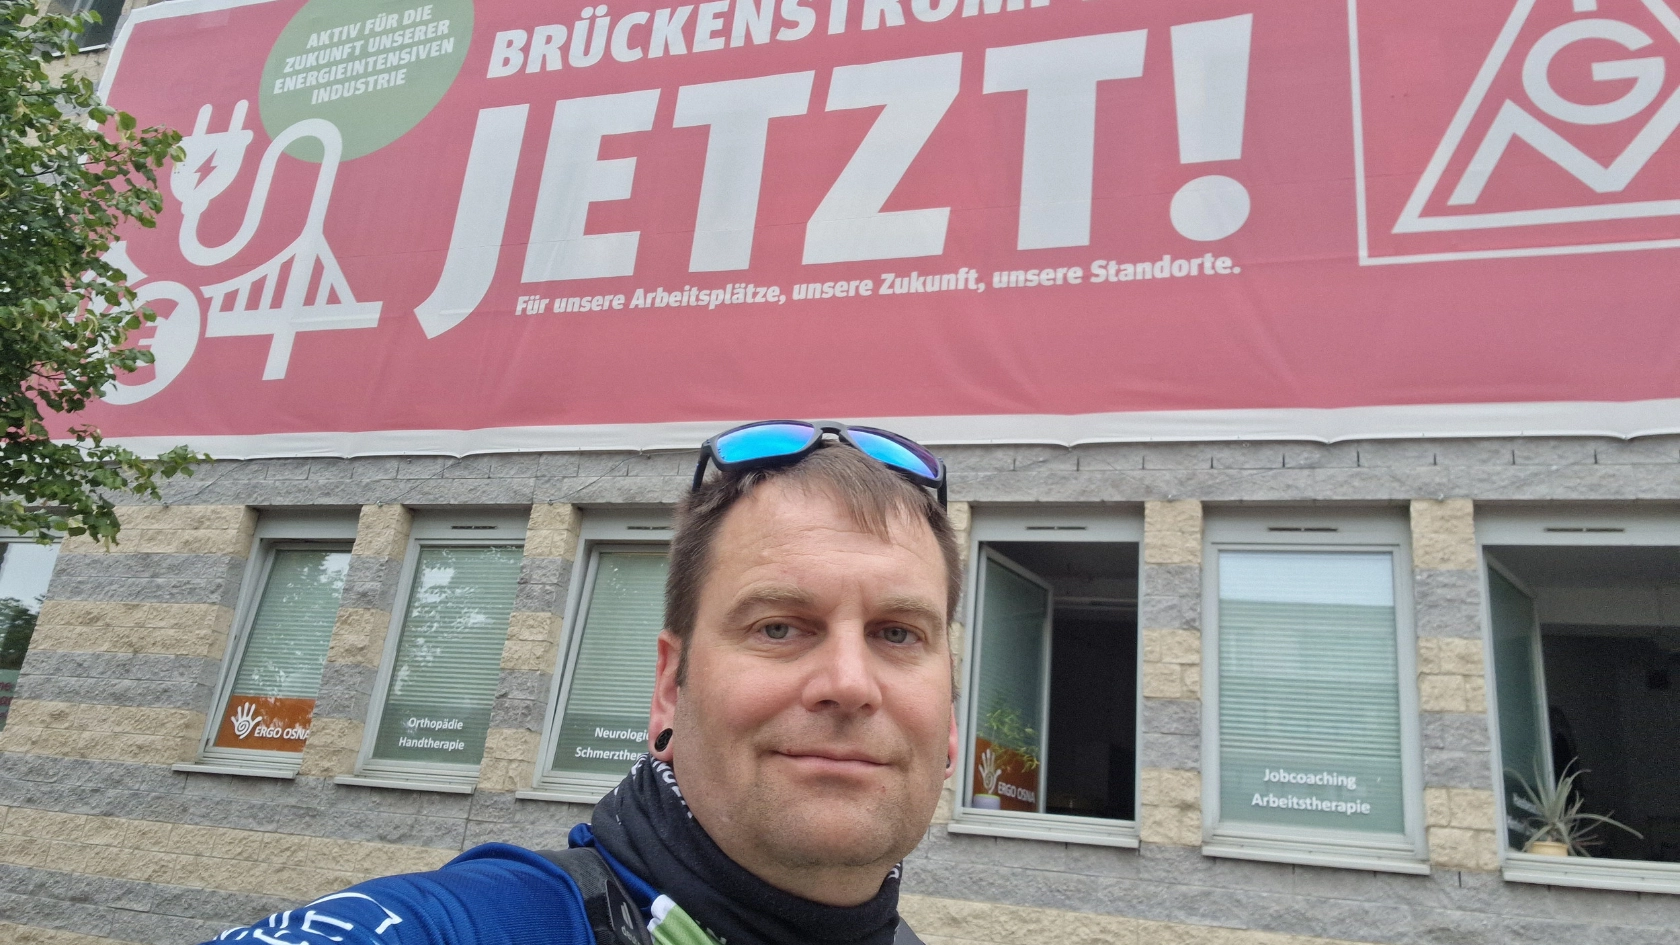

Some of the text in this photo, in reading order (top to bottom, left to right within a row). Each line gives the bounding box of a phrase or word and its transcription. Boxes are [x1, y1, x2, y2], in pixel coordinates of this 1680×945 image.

[306, 4, 433, 49] AKTIV FÜR DIE
[284, 19, 450, 73] ZUKUNFT UNSERER
[273, 37, 455, 94] ENERGIEINTENSIVEN
[311, 68, 407, 104] INDUSTRIE
[414, 13, 1253, 339] JETZT!
[515, 253, 1241, 315] Für unsere Arbeitsplätze, unsere Zukunft, unsere Standorte.
[254, 726, 311, 740] ERGO OSNA
[408, 717, 463, 730] Orthopädie
[399, 737, 465, 751] Handtherapie
[575, 747, 641, 760] Schmerzther
[998, 781, 1016, 797] ERGO
[1263, 768, 1357, 790] Jobcoaching
[1251, 793, 1371, 815] Arbeitstherapie
